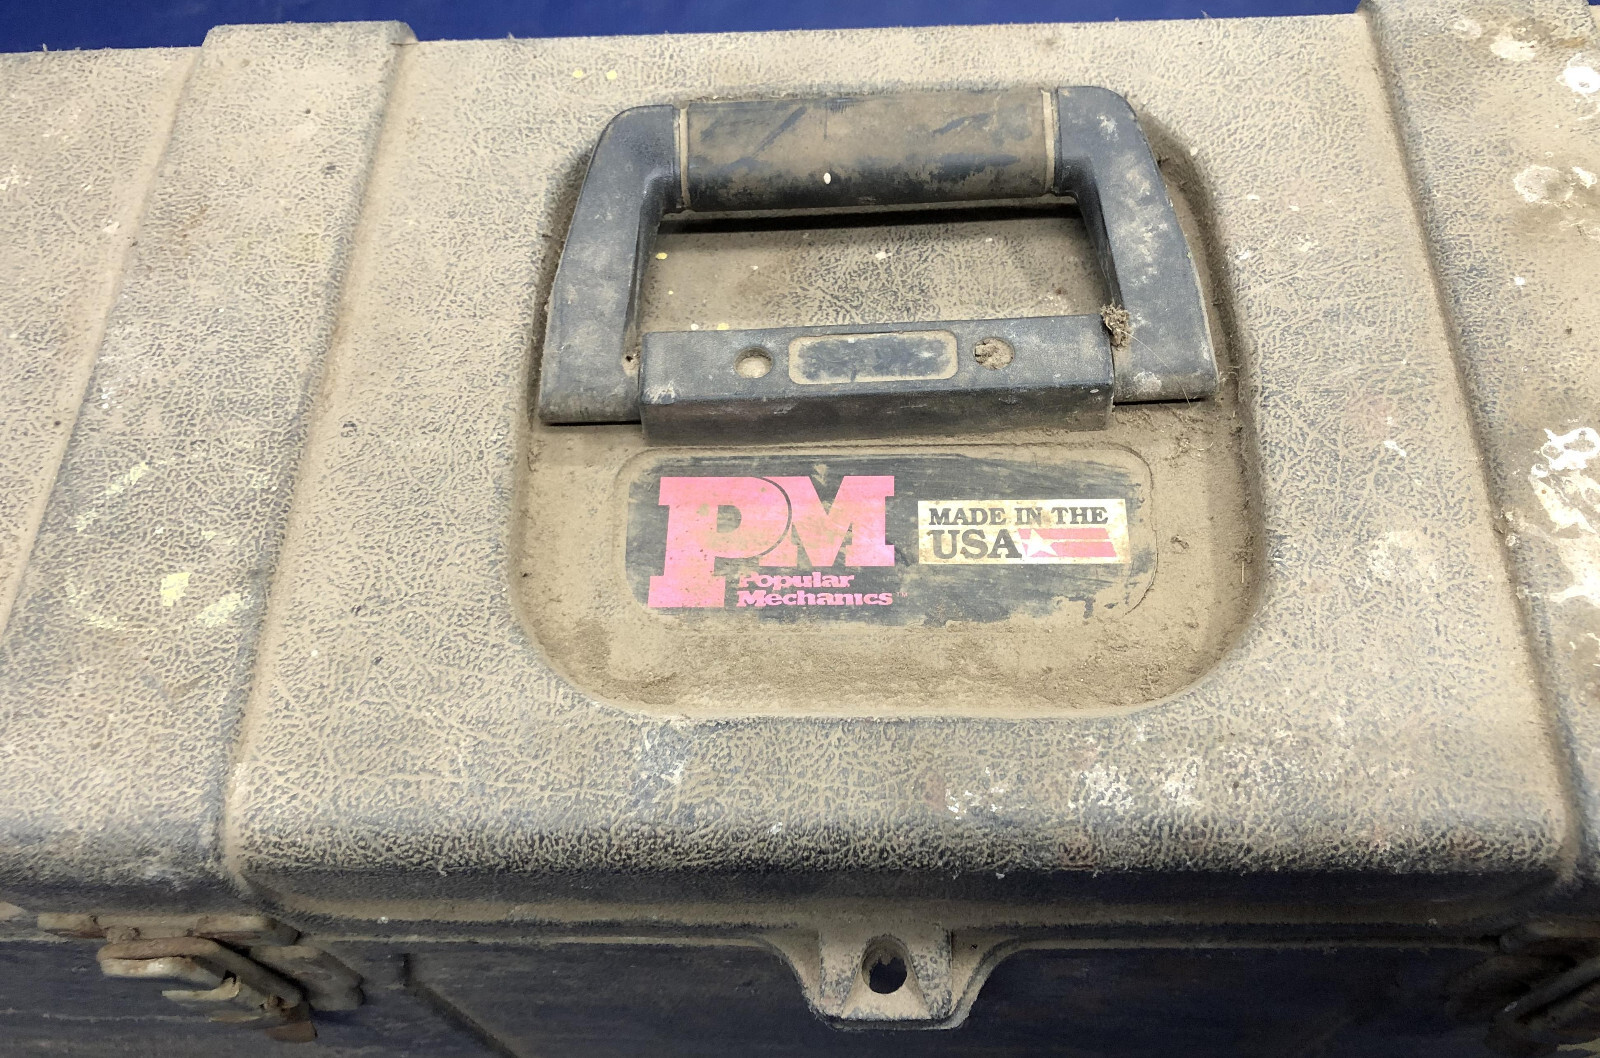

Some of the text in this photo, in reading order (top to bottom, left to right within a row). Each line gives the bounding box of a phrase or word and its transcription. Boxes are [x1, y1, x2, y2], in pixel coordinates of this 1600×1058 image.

[928, 506, 1108, 526] MADE IN THE
[647, 475, 895, 608] PM
[927, 528, 1022, 559] USA
[738, 571, 855, 591] Popular
